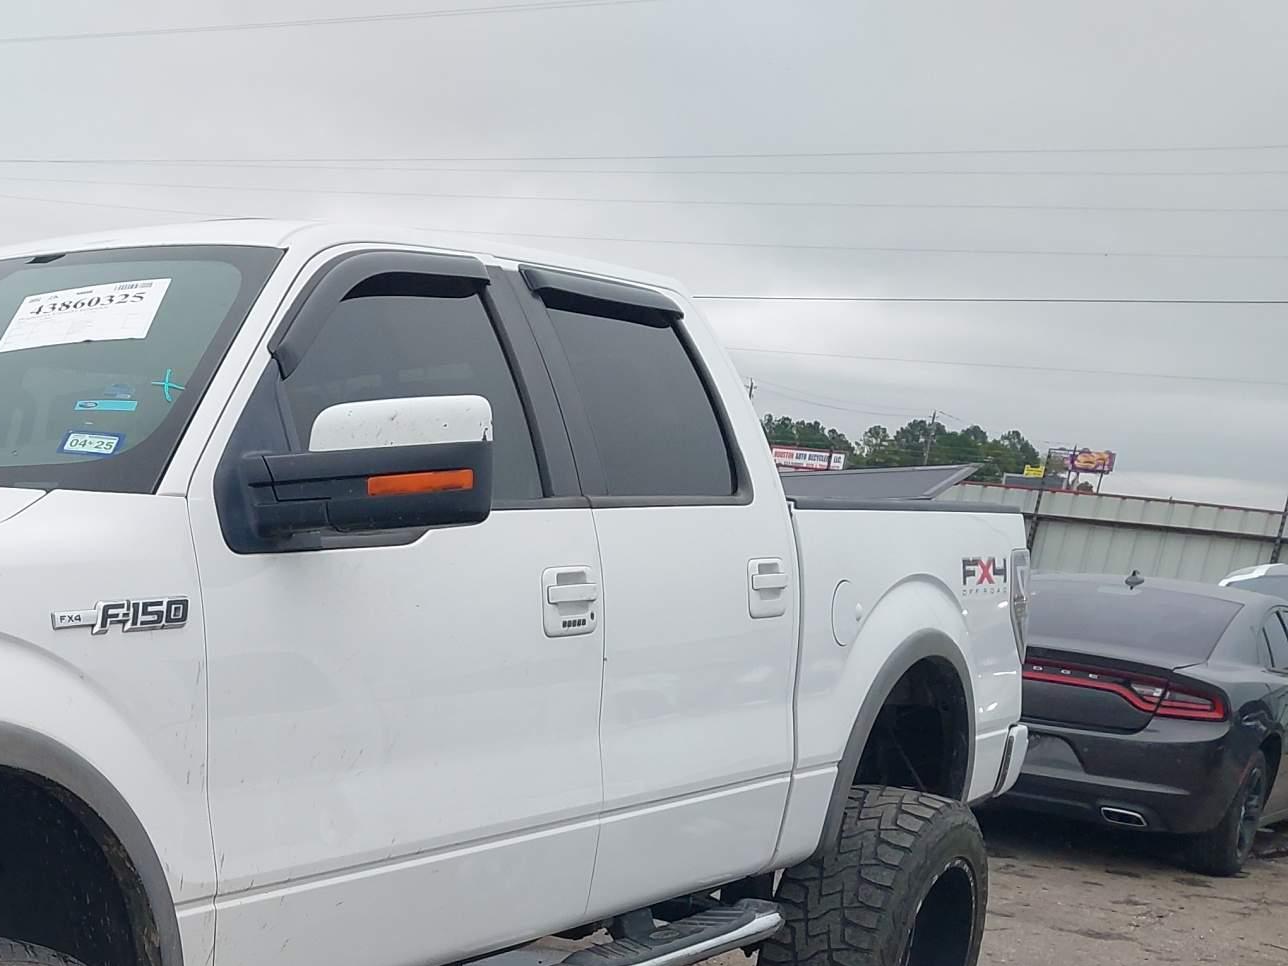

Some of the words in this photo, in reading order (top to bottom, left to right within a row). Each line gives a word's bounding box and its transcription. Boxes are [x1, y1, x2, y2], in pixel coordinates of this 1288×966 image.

[29, 290, 146, 316] 43860325
[962, 557, 1006, 586] FX4
[59, 611, 82, 623] FX4
[95, 596, 190, 630] F-150
